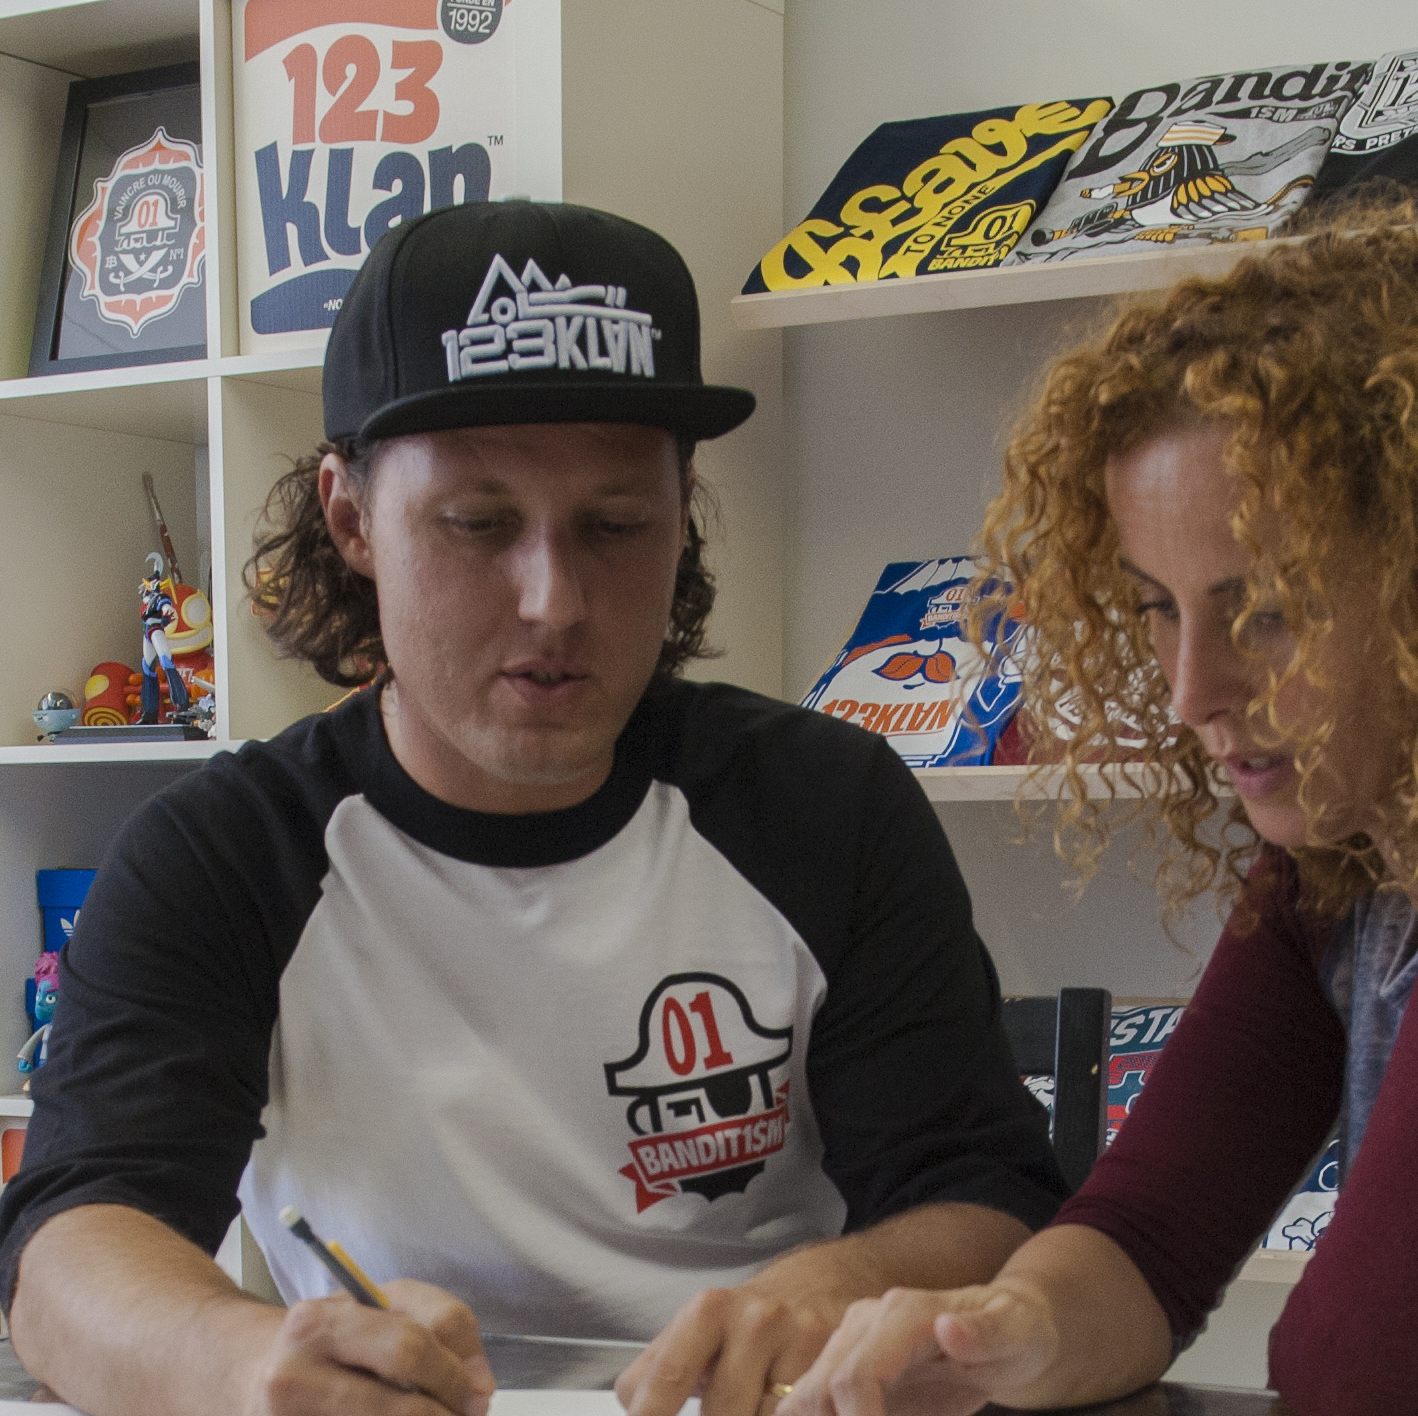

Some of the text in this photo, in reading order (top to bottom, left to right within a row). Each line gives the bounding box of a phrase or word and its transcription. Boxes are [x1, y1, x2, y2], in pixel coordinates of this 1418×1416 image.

[449, 8, 492, 33] 1992
[282, 34, 443, 146] 123
[114, 174, 187, 220] VAINCRE OU MOURIR
[137, 199, 160, 229] 01
[903, 183, 996, 256] TO NONE
[984, 209, 1021, 240] 01
[946, 589, 964, 601] 01
[662, 991, 734, 1076] 01
